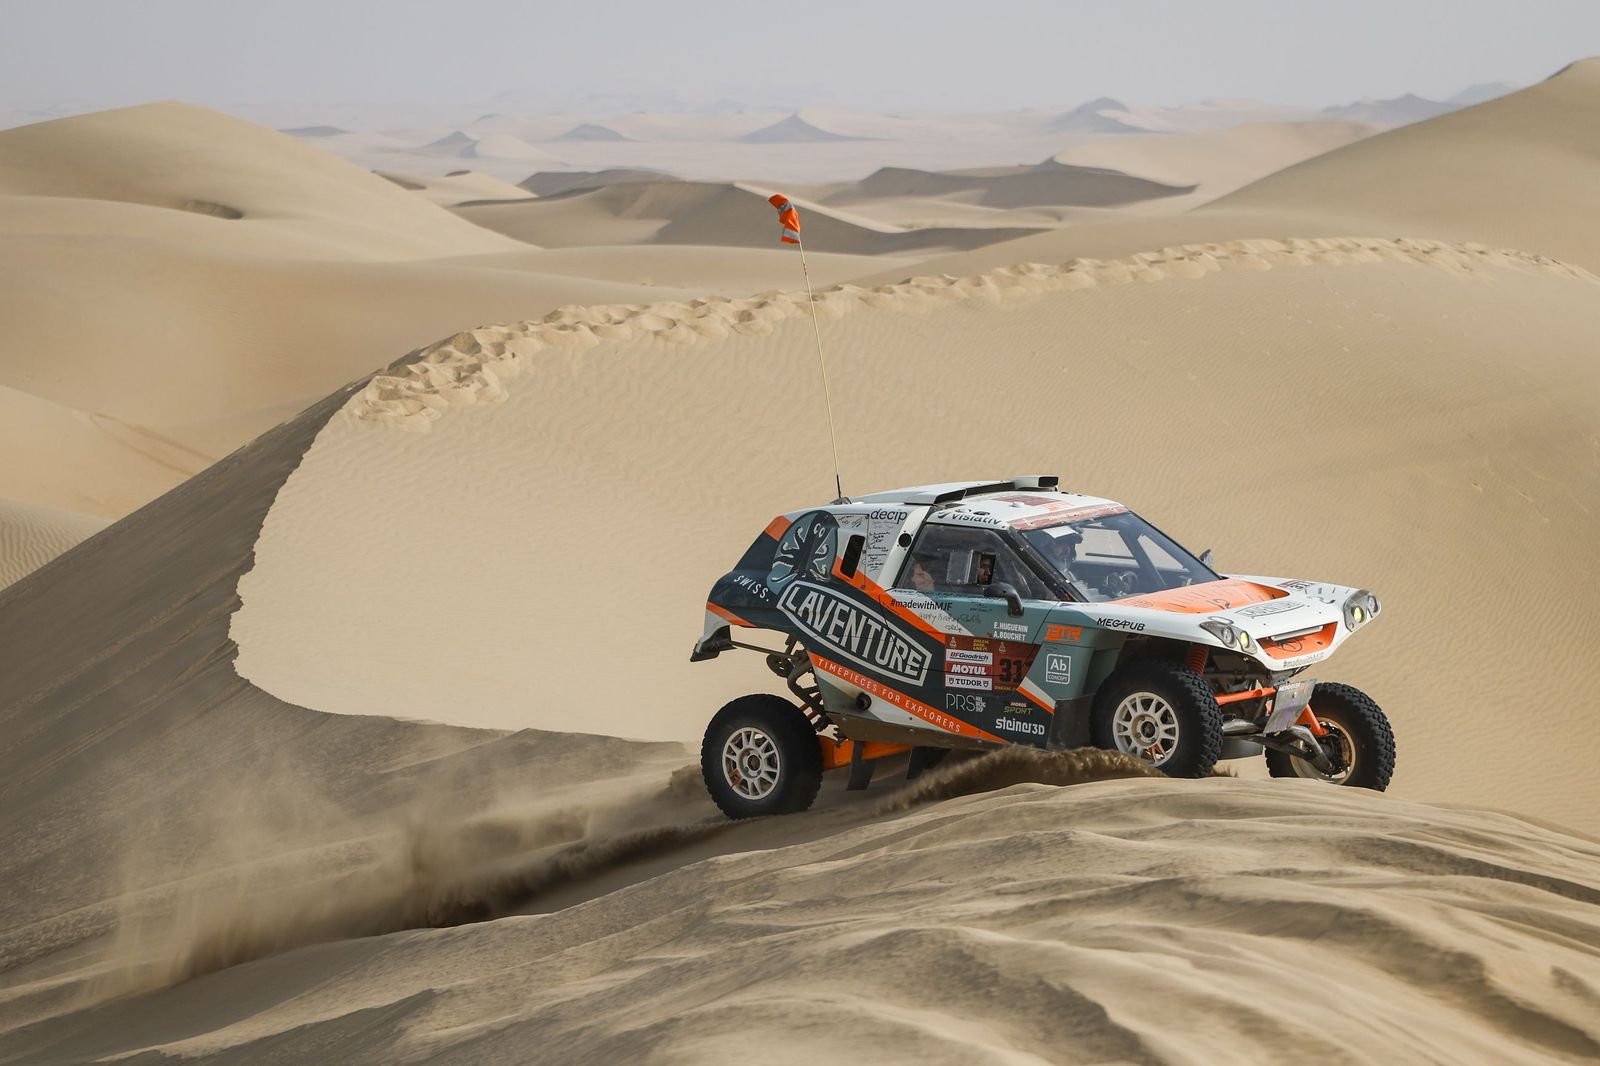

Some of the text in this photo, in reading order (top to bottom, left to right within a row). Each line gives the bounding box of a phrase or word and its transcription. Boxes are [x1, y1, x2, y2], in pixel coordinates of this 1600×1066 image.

[870, 508, 908, 525] decip
[890, 598, 953, 611] #madewithMJF
[785, 586, 923, 677] LAVENTURE
[950, 651, 989, 660] BFGoodrich
[951, 664, 987, 675] MOTUL
[1050, 658, 1067, 672] Ab
[955, 678, 982, 687] TUDOR
[1048, 674, 1068, 682] CONCEPT
[817, 657, 878, 692] TIMEPIECES
[881, 689, 901, 704] FOR
[905, 699, 962, 733] EXPLORERS
[945, 692, 976, 712] PRS
[1003, 705, 1033, 715] SPORT
